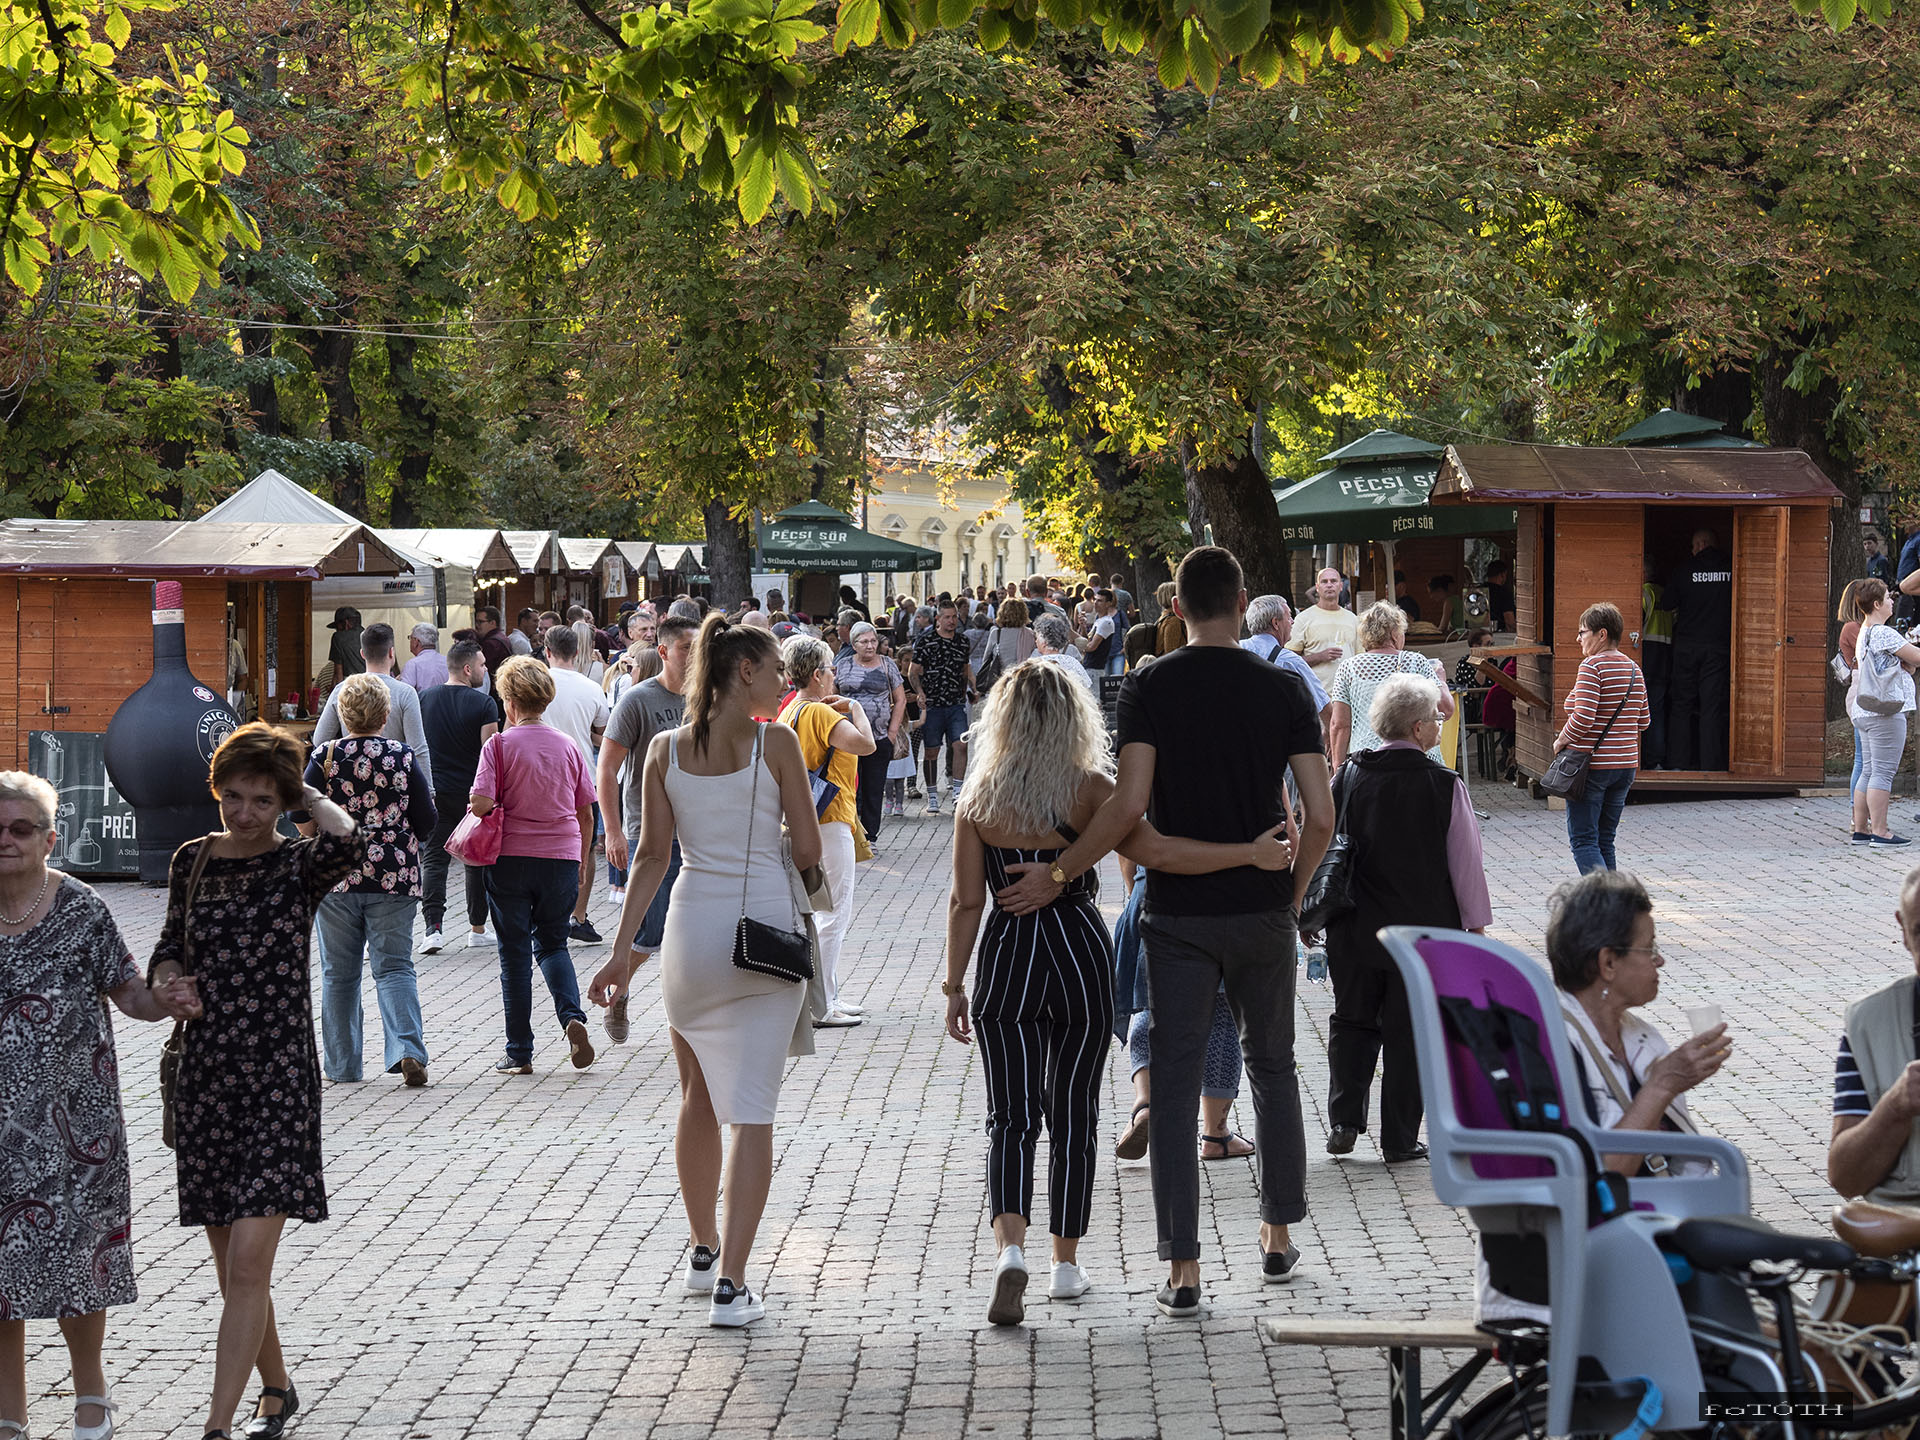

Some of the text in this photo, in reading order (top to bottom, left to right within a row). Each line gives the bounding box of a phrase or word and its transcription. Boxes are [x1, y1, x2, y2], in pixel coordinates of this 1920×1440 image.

[1338, 475, 1404, 495] PÉCSI
[1297, 524, 1315, 540] SÖR
[1392, 514, 1434, 533] PÉCSI SÖR
[771, 529, 848, 542] PÉCSI SÖR
[1692, 571, 1731, 583] SECURITY
[200, 711, 239, 734] UNICUM
